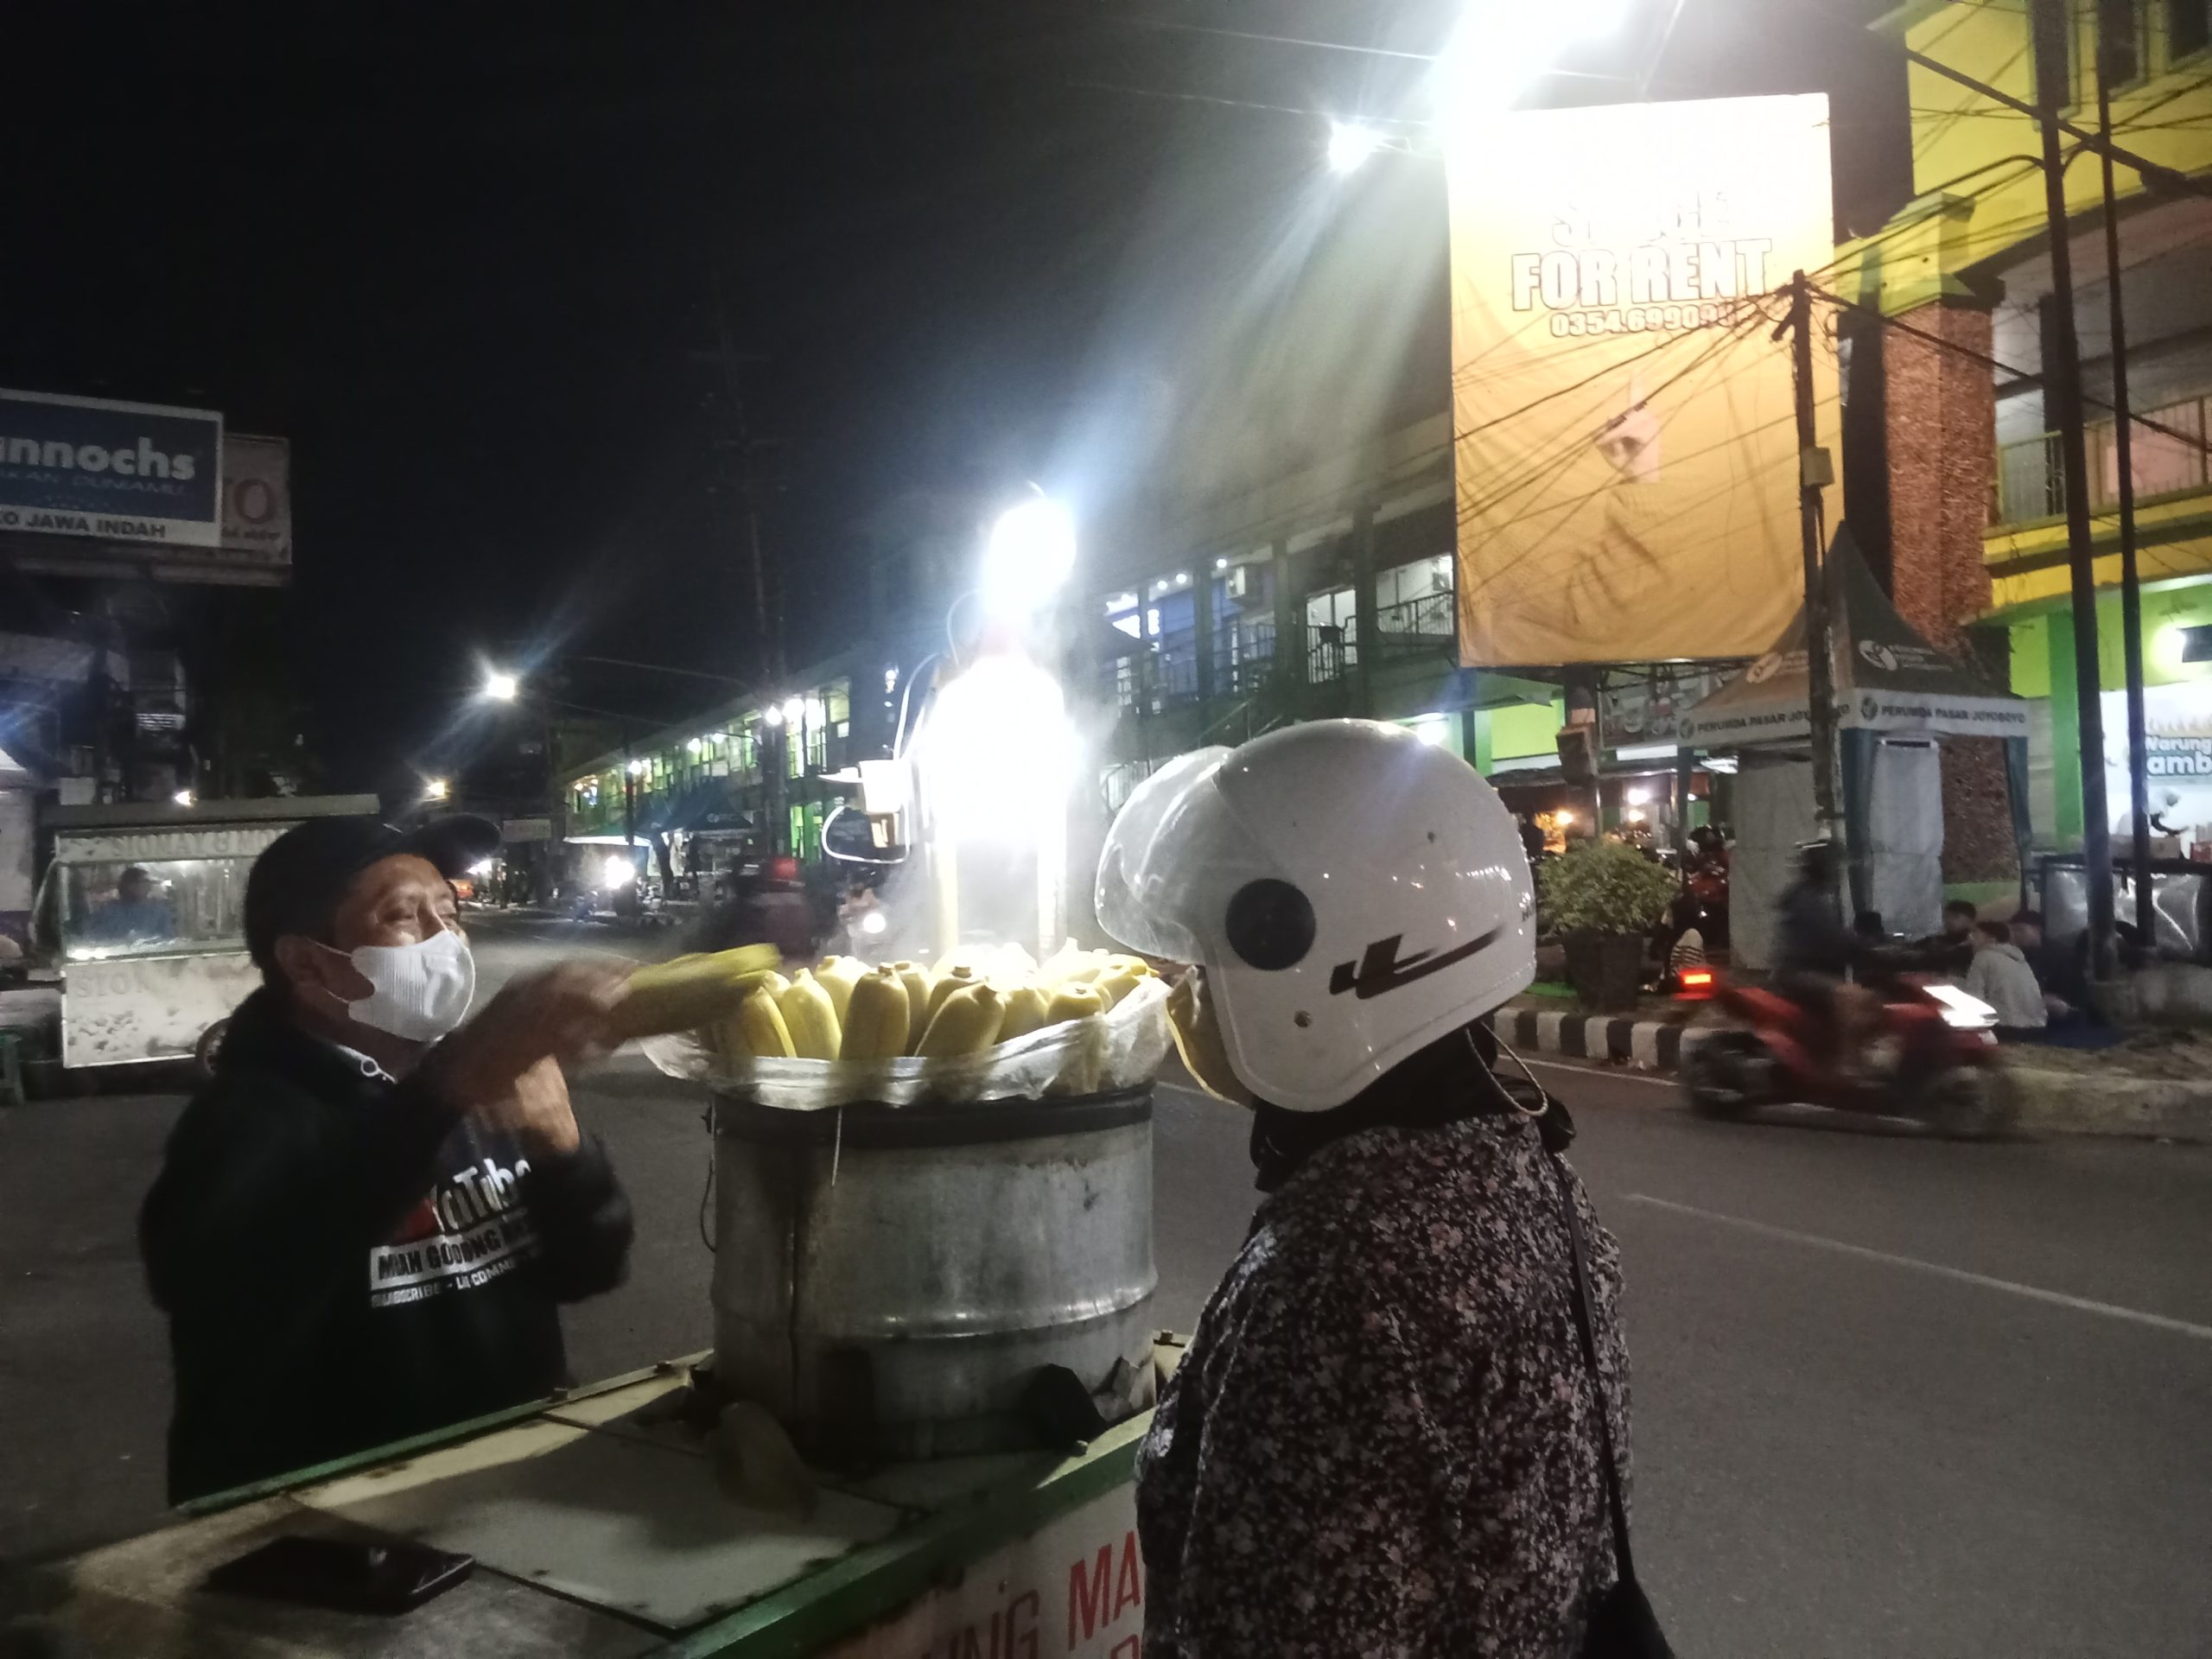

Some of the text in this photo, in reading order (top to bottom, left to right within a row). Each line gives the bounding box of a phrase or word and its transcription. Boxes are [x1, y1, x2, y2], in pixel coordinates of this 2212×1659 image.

[1511, 238, 1772, 312] FOR RENT
[0, 435, 196, 480] nnochs
[25, 512, 91, 532] JAWA
[97, 518, 167, 538] INDAH
[1697, 717, 1747, 733] PERUMDA
[1881, 704, 2026, 724] PERUMDA PASAR JOYOBOYO
[2146, 749, 2212, 775] amb
